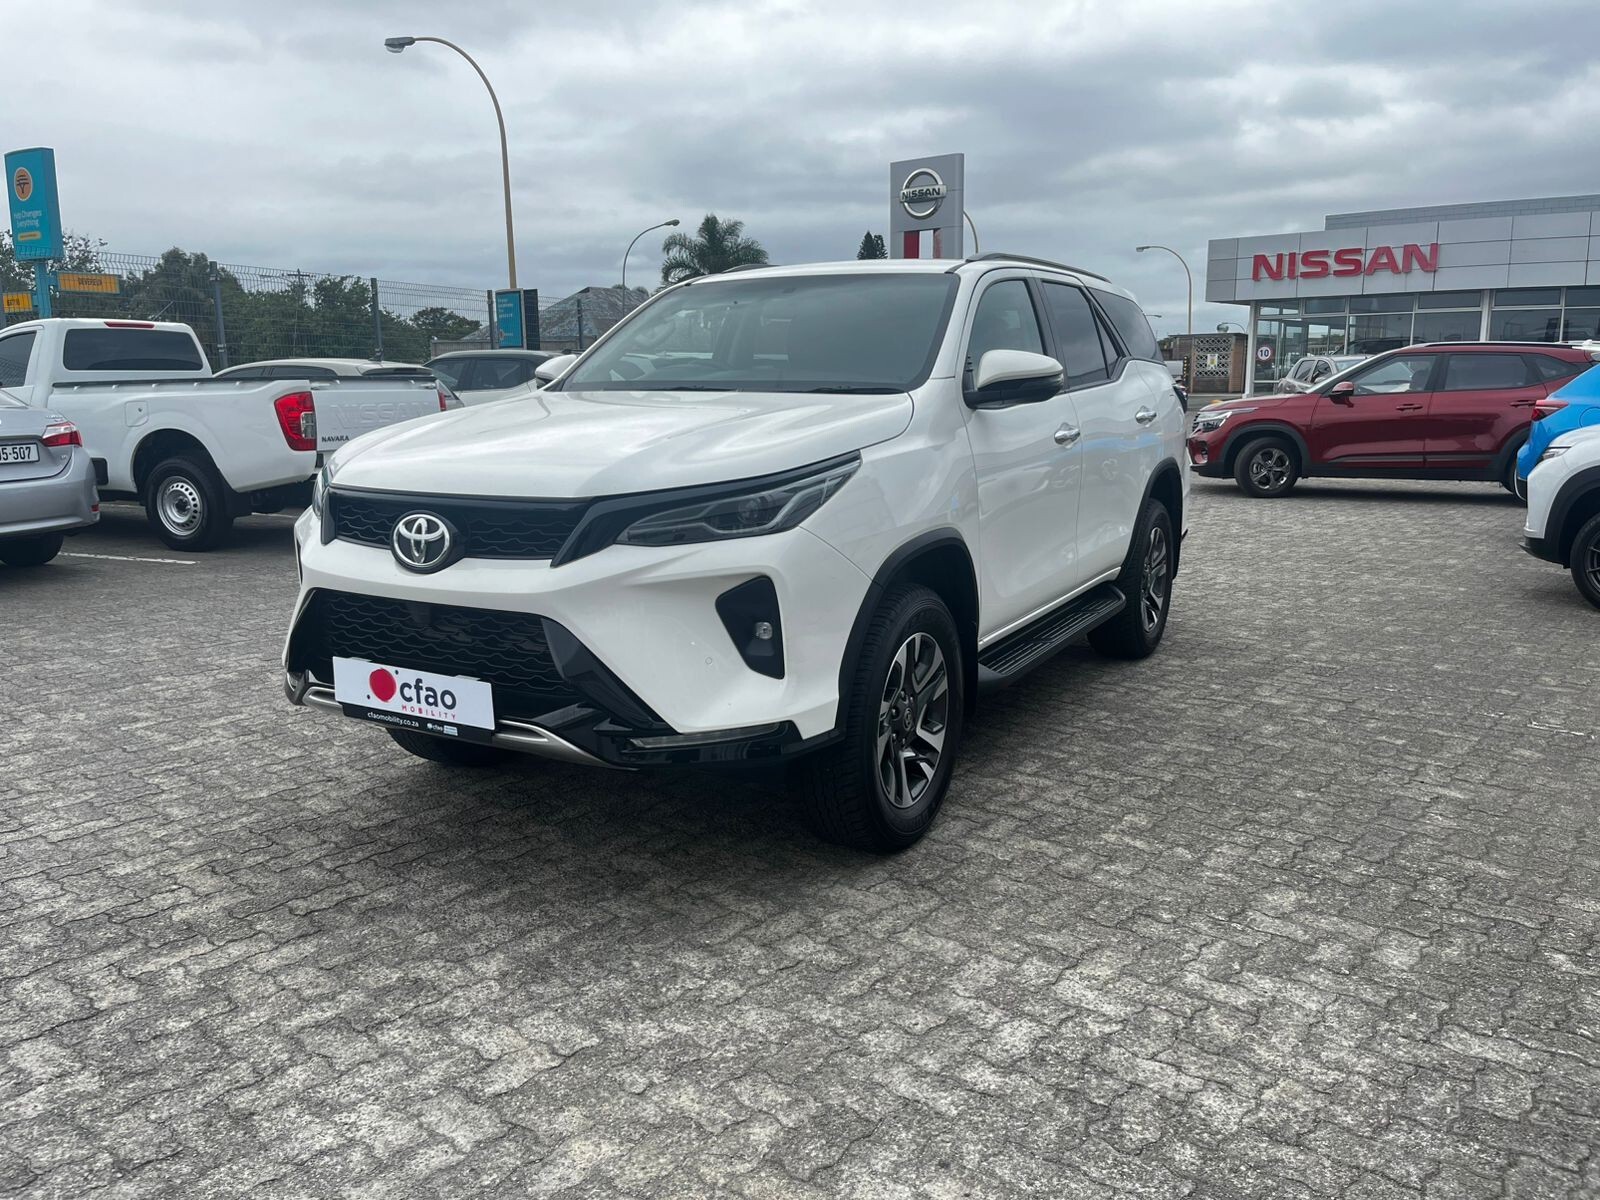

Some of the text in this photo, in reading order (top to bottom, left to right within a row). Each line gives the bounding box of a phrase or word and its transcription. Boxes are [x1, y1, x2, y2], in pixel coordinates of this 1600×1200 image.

[902, 187, 940, 200] NISSAN
[1252, 243, 1440, 282] NISSAN
[1260, 349, 1270, 358] 10
[321, 435, 350, 443] NAVARA
[400, 678, 457, 710] cfao
[367, 711, 419, 728] cfaomobility.co.za
[402, 704, 457, 720] MOBILITY
